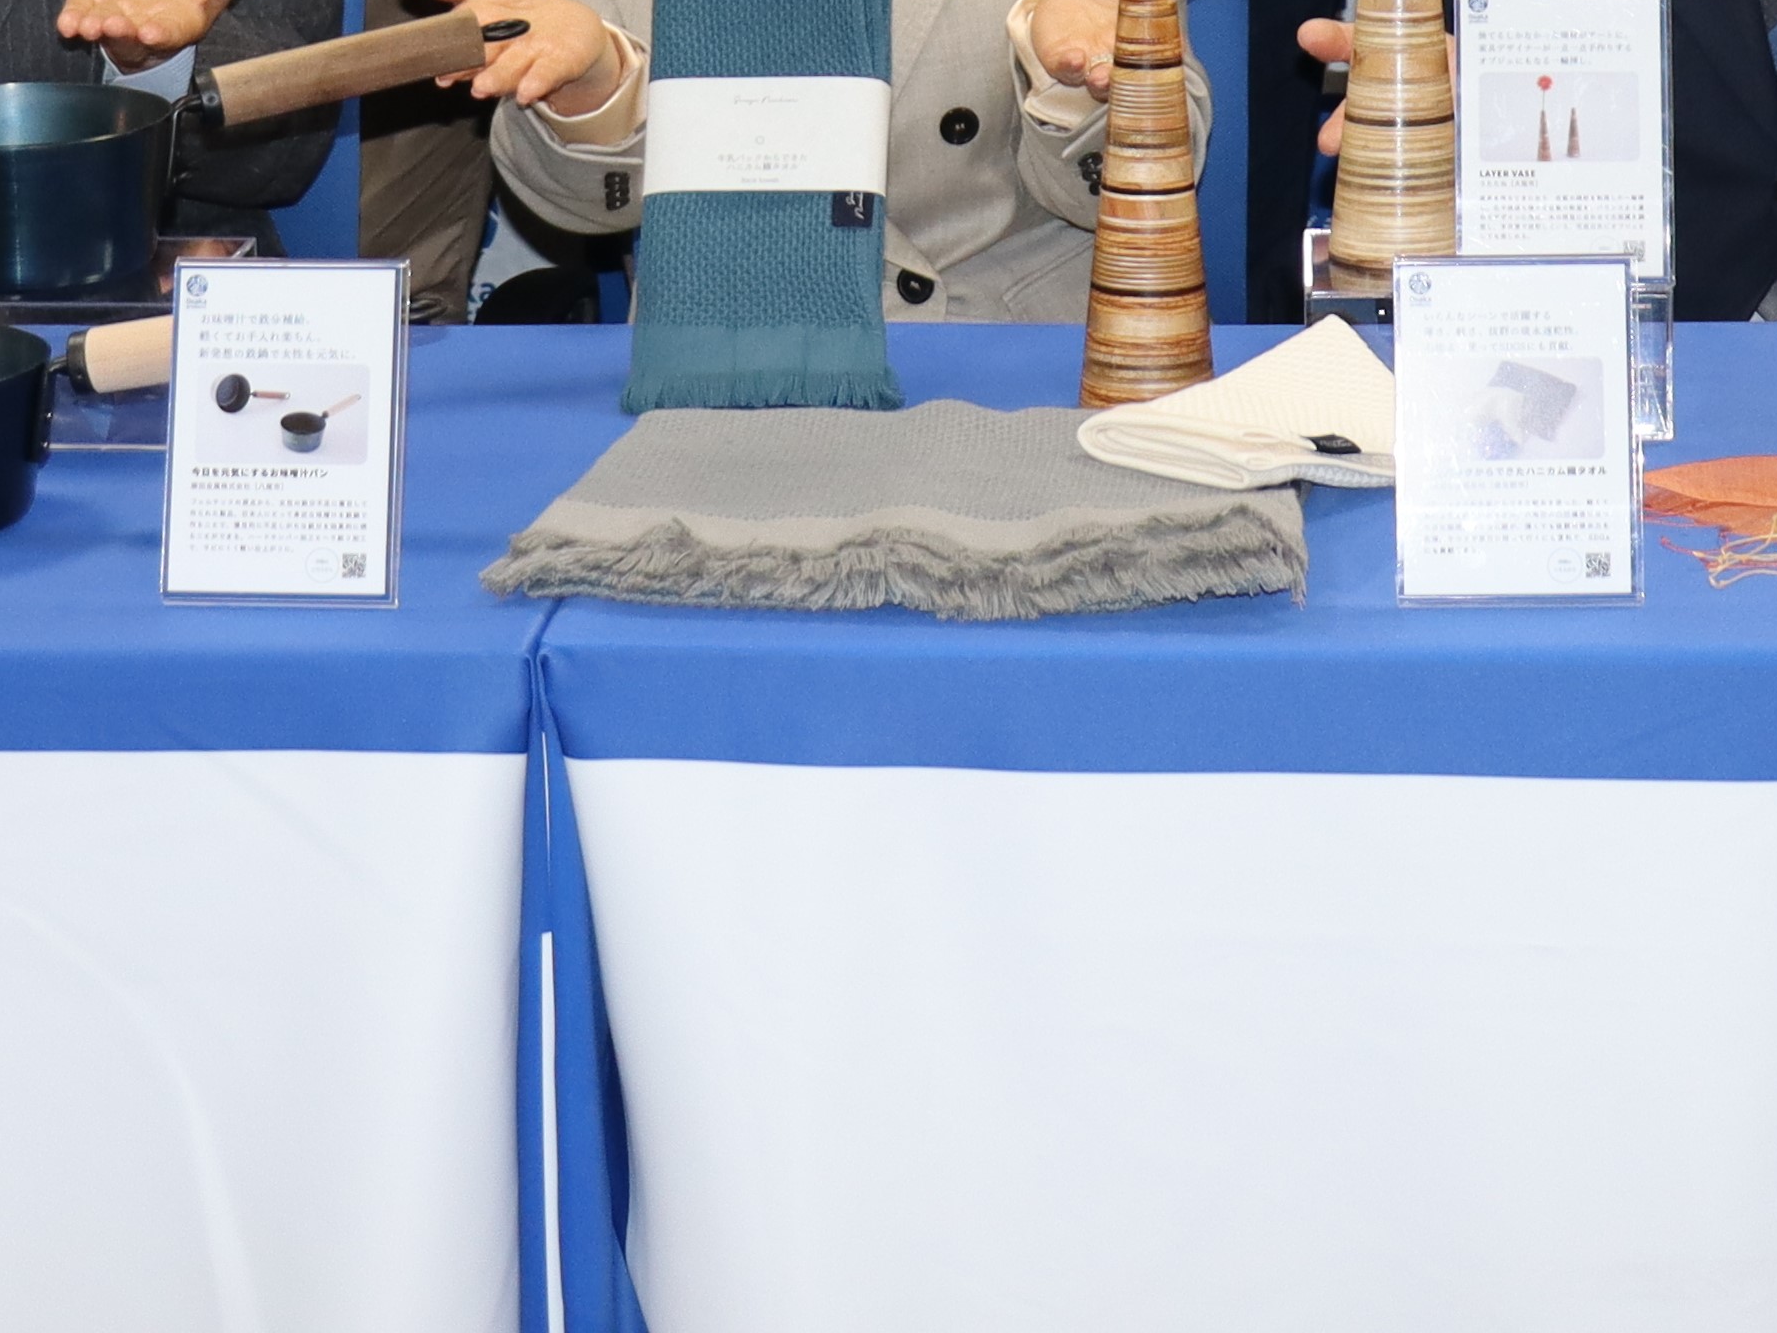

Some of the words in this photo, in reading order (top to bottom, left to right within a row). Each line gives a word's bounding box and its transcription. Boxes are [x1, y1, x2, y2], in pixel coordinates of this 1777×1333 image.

[1479, 169, 1508, 178] LAYER
[1511, 169, 1536, 178] VASE
[191, 466, 329, 480] 今日を元気にするお味噌汁パン
